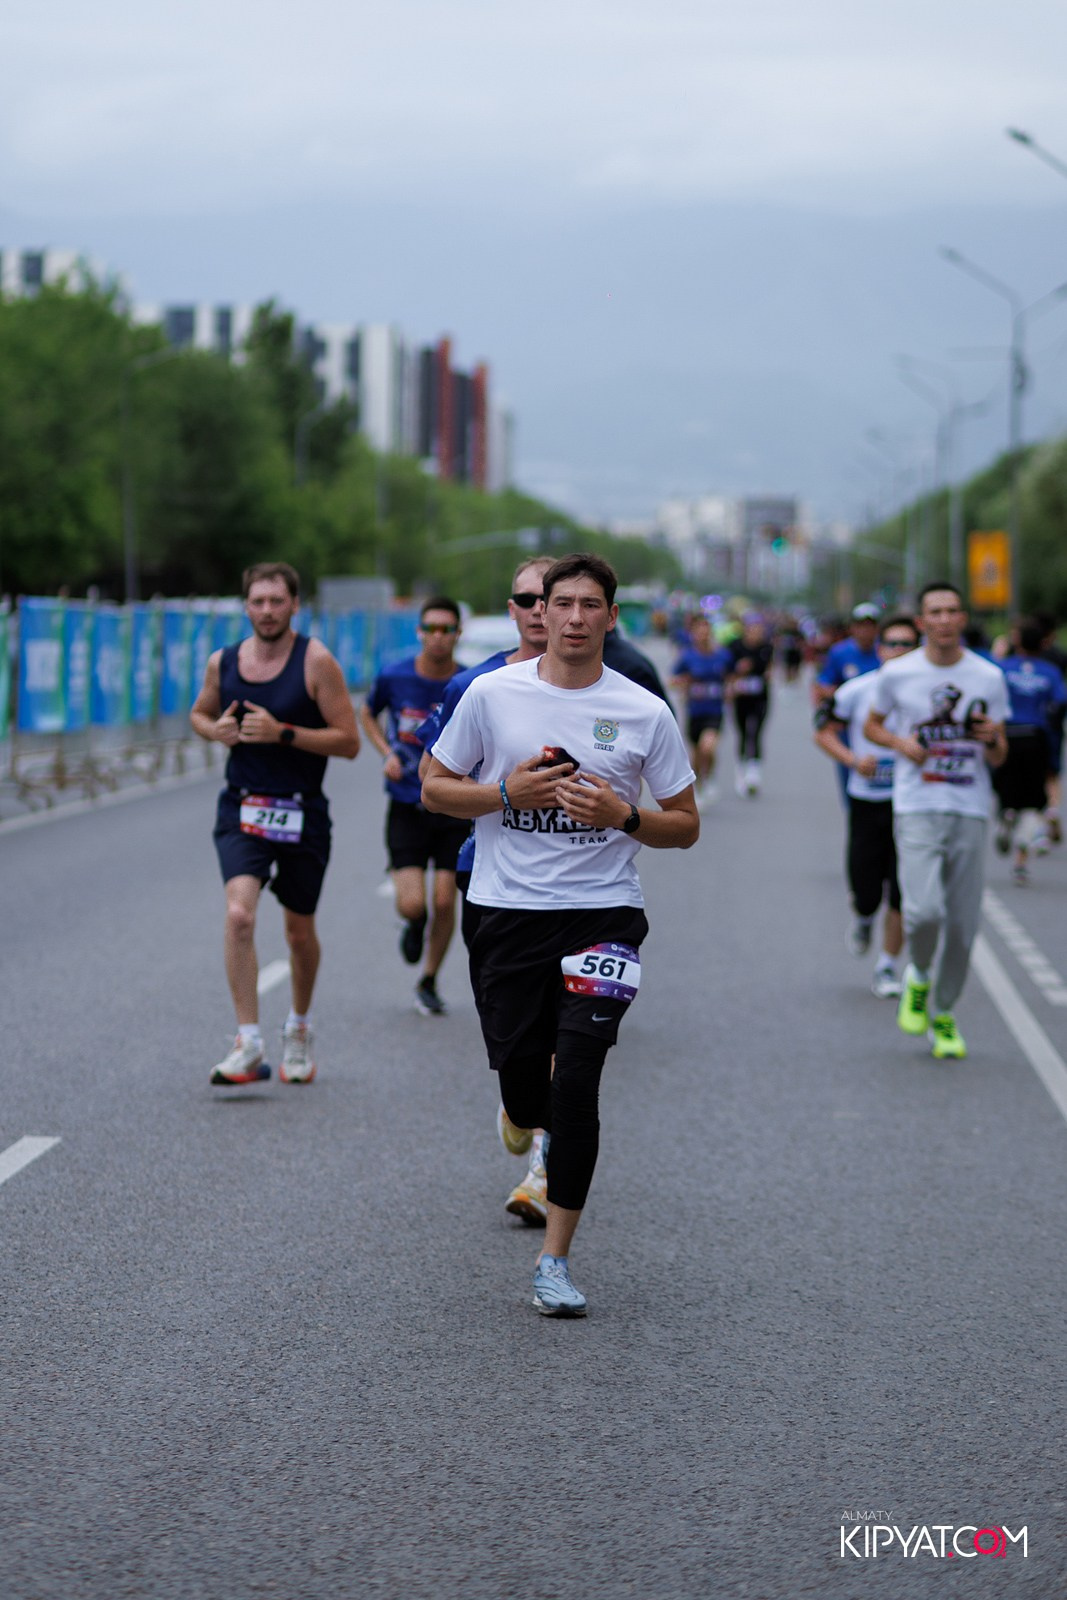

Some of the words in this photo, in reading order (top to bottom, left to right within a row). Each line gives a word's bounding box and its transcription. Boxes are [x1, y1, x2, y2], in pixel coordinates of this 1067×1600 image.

[255, 811, 289, 826] 214
[569, 836, 608, 845] TEAM
[579, 954, 627, 980] 561
